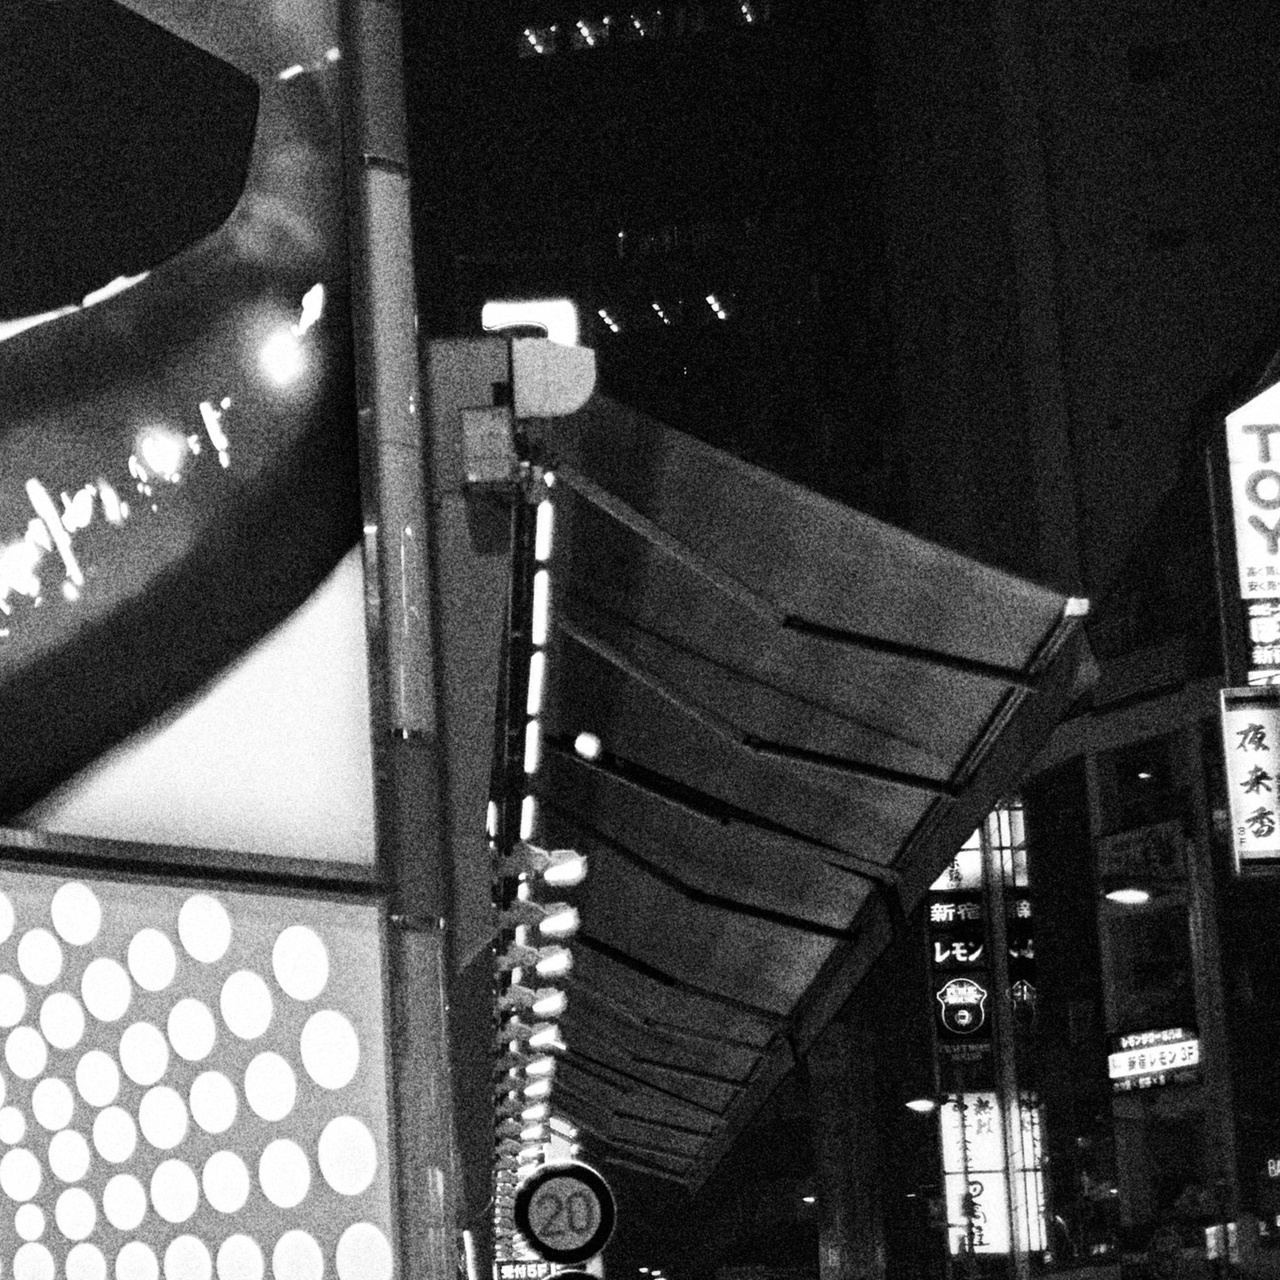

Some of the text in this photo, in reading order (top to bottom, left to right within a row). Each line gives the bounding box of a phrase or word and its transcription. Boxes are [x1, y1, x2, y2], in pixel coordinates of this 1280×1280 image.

[930, 902, 980, 923] 新宿
[933, 941, 984, 963] レモン
[1127, 1045, 1194, 1072] 新宿レモン 3F
[535, 1190, 594, 1239] 20
